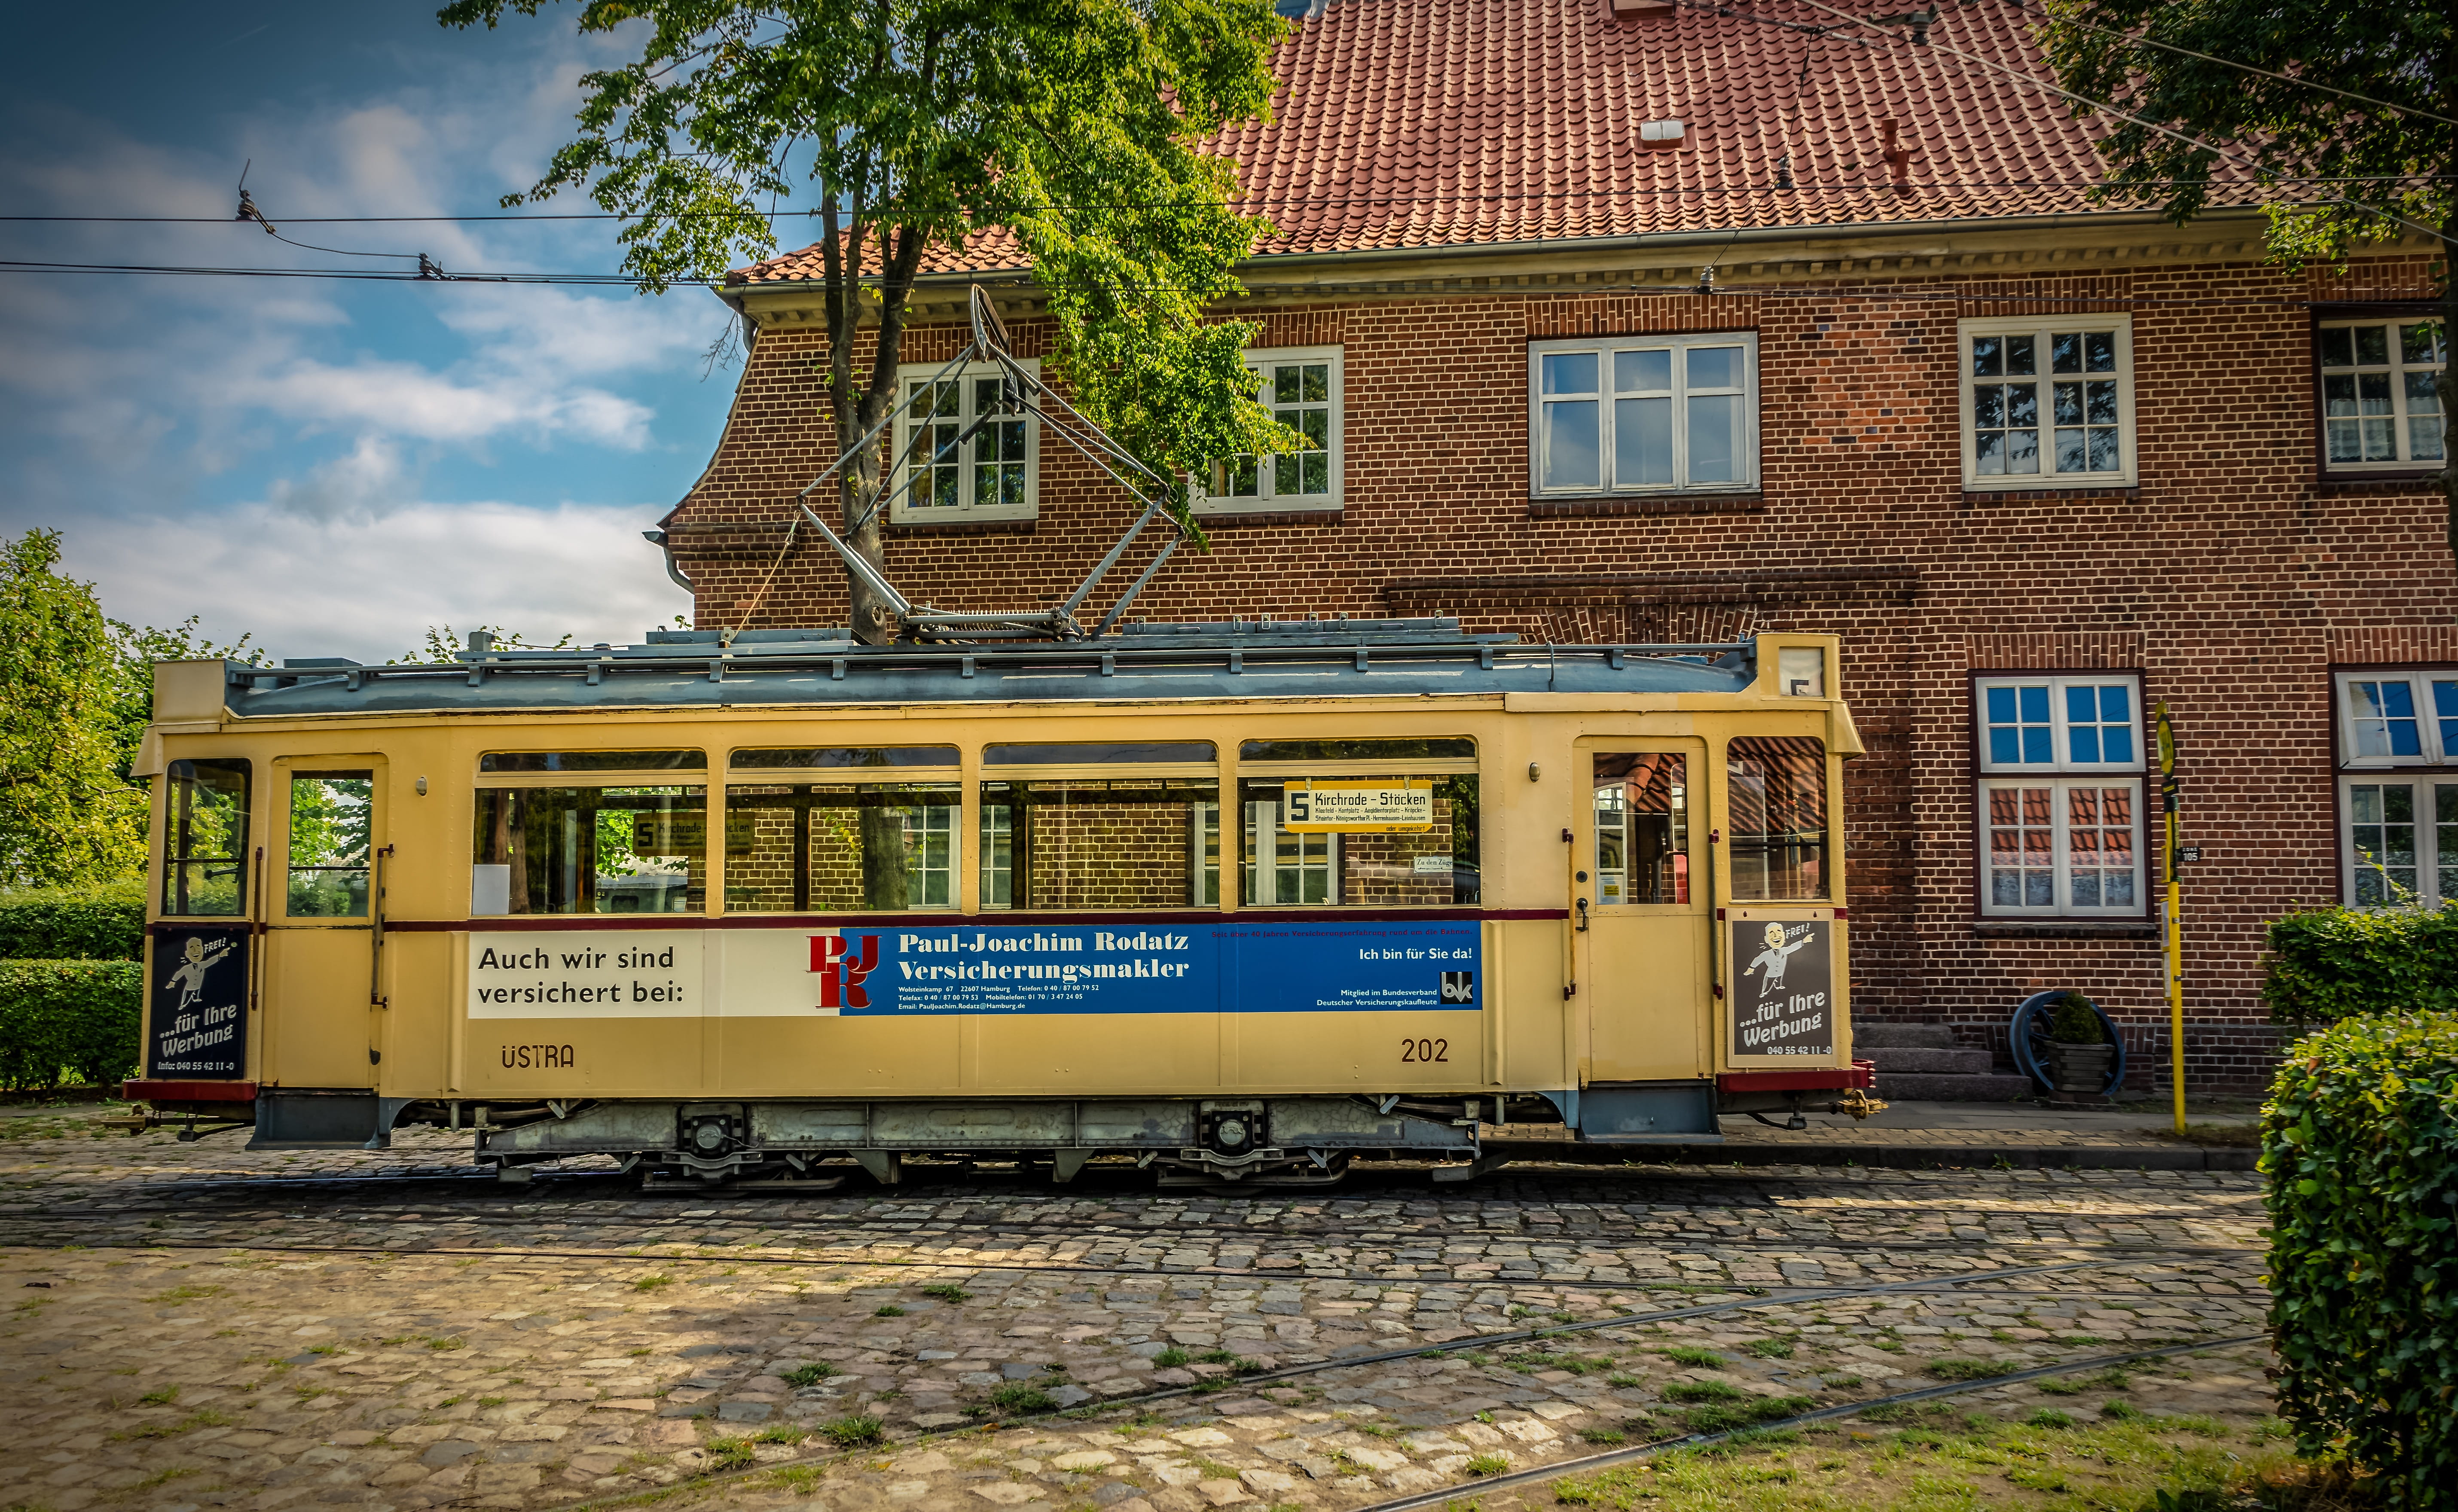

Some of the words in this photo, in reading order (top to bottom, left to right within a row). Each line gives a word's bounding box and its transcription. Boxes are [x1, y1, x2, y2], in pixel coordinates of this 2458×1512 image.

[1291, 793, 1309, 822] 5
[1315, 792, 1367, 806] Kirchrode
[1380, 792, 1426, 805] Stöcken
[638, 823, 653, 847] 5
[1398, 825, 1426, 833] umgekehrt
[2183, 853, 2198, 861] 105
[898, 933, 1083, 953] Paul-Joachim
[1093, 931, 1189, 951] Rodatz
[1786, 922, 1810, 939] FREI!
[204, 938, 226, 954] FREI!
[477, 947, 550, 969] Auch
[560, 946, 607, 969] wir
[617, 946, 674, 969] sind
[1360, 948, 1378, 960] Ich
[1383, 948, 1402, 960] bin
[1406, 948, 1425, 959] für
[1429, 948, 1448, 959] Sie
[1452, 948, 1472, 959] da!
[897, 958, 1190, 984] Versicherungsmakler
[477, 981, 621, 1004] versichert
[632, 980, 683, 1003] bei:
[1341, 989, 1369, 997] Mitglied
[159, 1013, 200, 1038] ...für
[204, 1004, 237, 1025] Ihre
[1740, 1002, 1783, 1027] ...für
[1789, 992, 1825, 1014] Ihre
[162, 1024, 234, 1057] Werbung
[1744, 1012, 1822, 1047] Werbung
[501, 1044, 574, 1069] ÜSTRA
[1401, 1038, 1449, 1063] 202
[1767, 1046, 1783, 1055] 040
[1785, 1046, 1795, 1055] 55
[1798, 1046, 1808, 1055] 42
[1811, 1046, 1820, 1055] 11
[158, 1061, 175, 1070] Info:
[177, 1062, 191, 1070] 040
[192, 1062, 202, 1070] 55
[203, 1062, 214, 1070] 42
